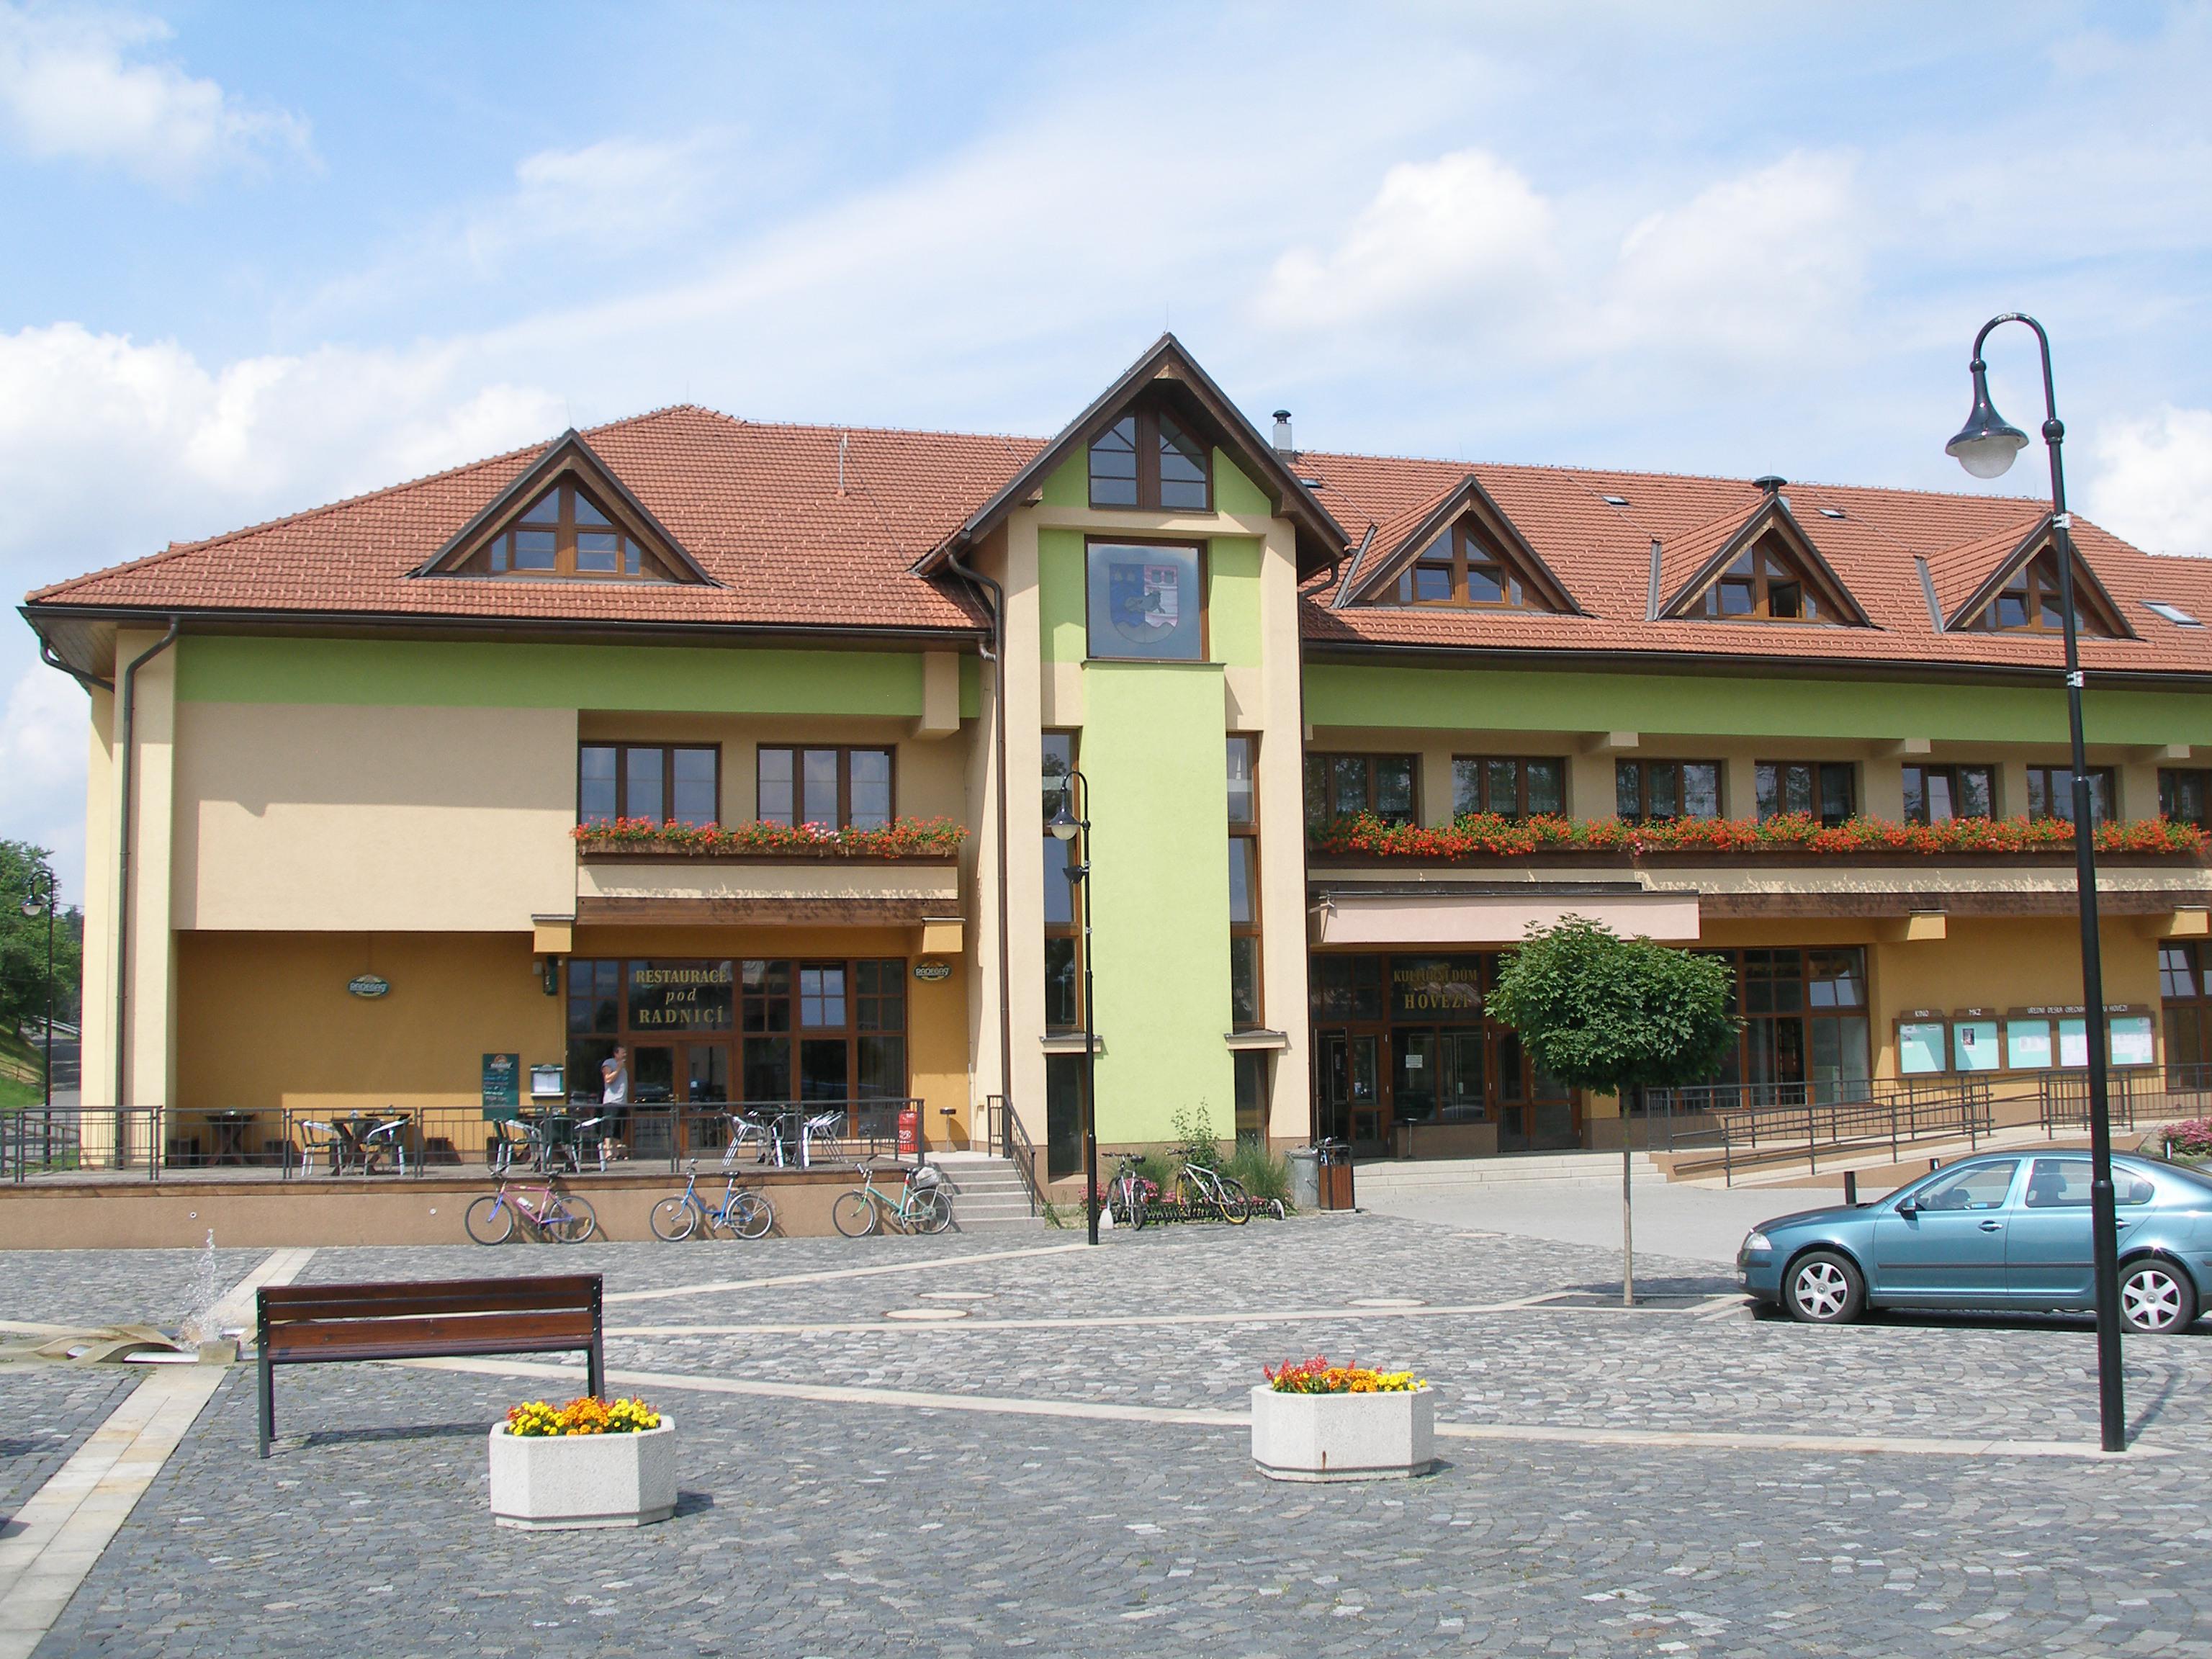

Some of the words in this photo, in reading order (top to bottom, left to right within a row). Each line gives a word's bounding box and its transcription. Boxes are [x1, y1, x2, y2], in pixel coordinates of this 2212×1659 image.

[636, 969, 727, 983] RESTAURACE
[665, 987, 696, 1005] pod
[639, 1006, 723, 1023] RADNICÍ
